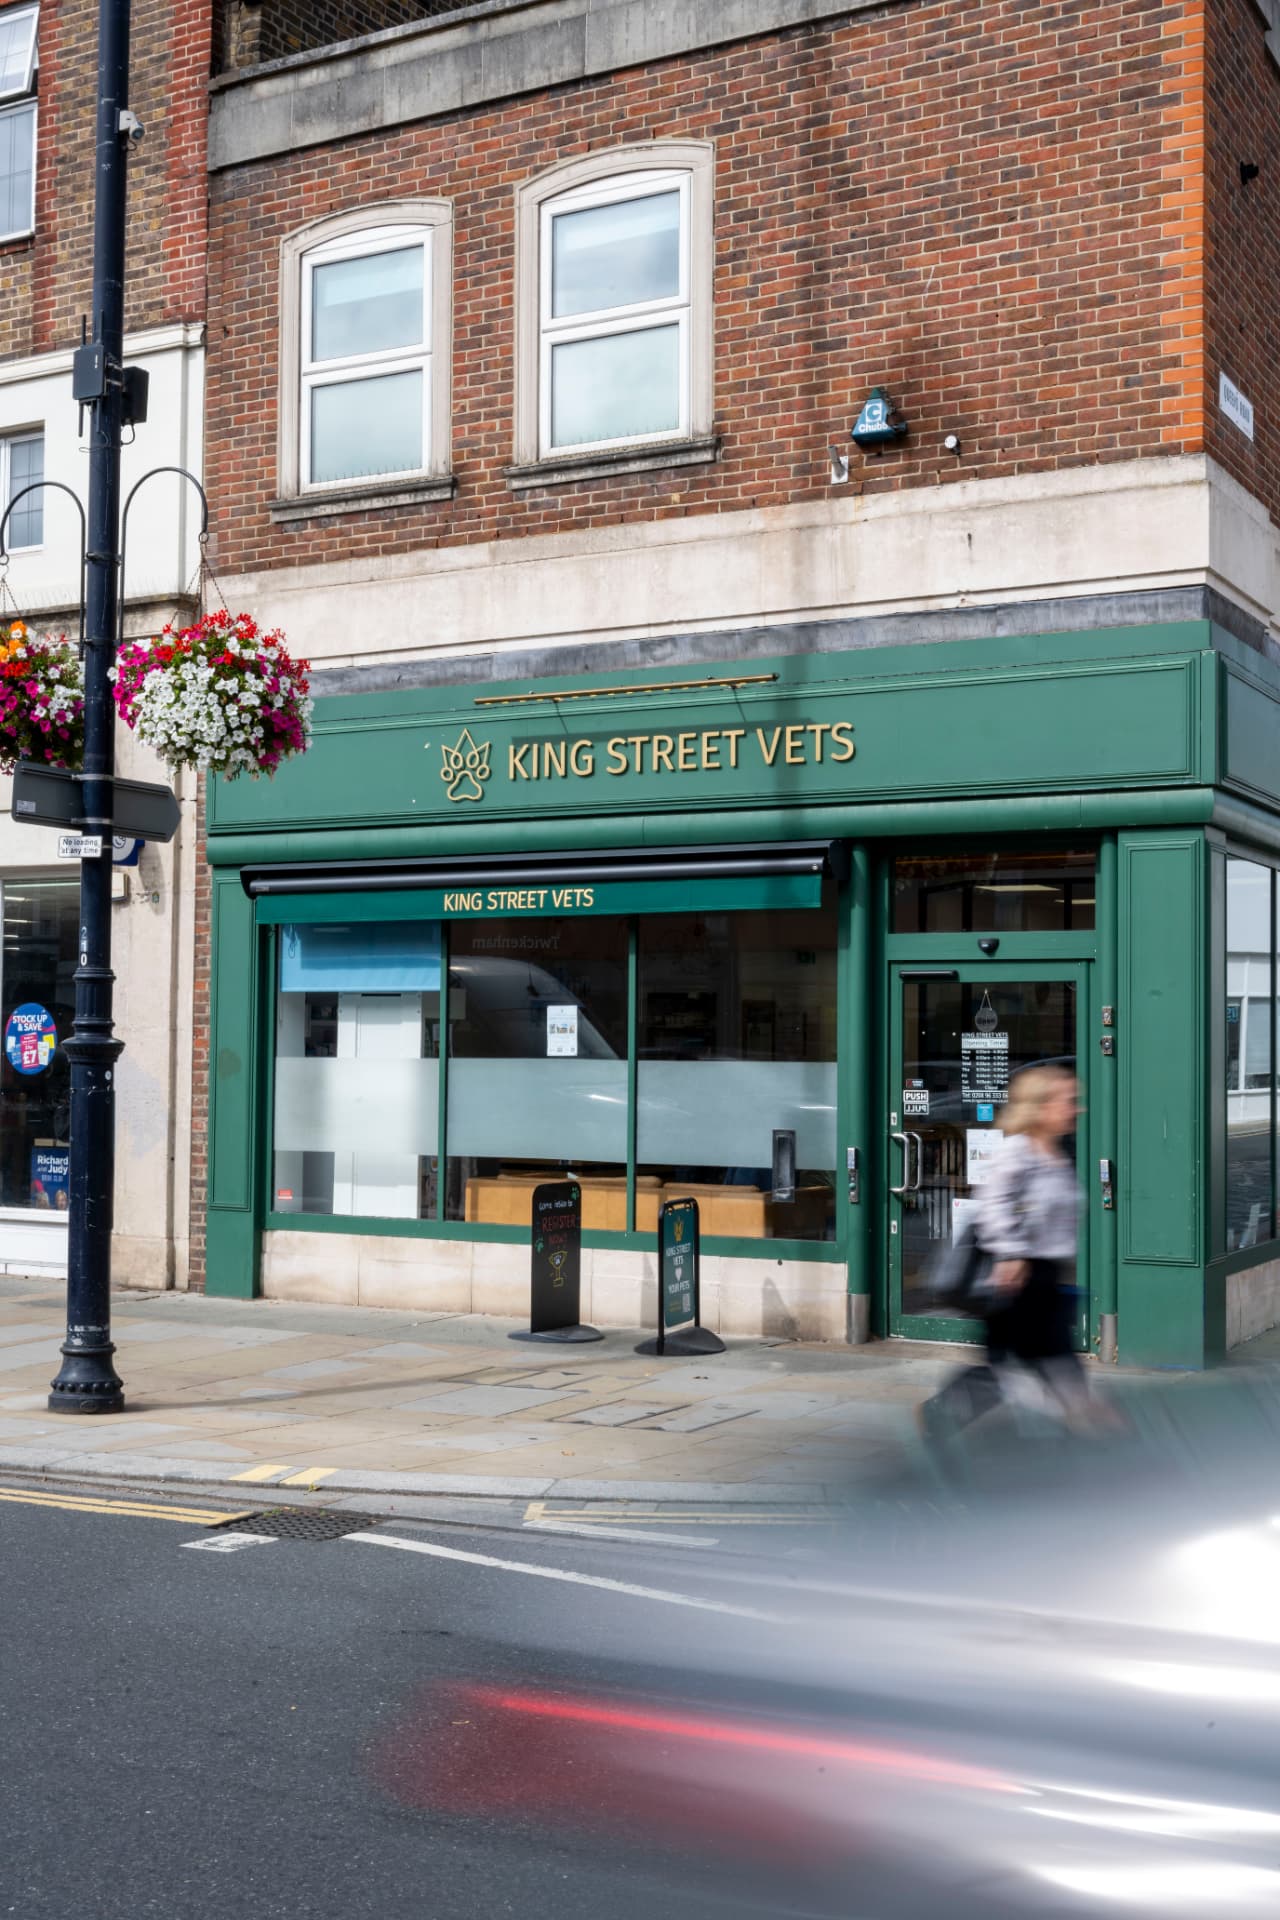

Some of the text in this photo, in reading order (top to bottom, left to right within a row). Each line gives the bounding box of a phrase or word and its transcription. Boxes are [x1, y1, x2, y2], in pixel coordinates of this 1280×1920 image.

[858, 422, 889, 433] Chubb
[508, 721, 856, 781] KING STREET VETS
[73, 838, 98, 848] loading
[443, 887, 595, 912] KING STREET VETS
[12, 1014, 48, 1025] STOCK UP
[24, 1022, 42, 1032] SAVE
[23, 1049, 37, 1065] £7
[905, 1092, 926, 1100] PUSH
[37, 1154, 69, 1166] Richard
[47, 1165, 69, 1176] Judy
[542, 1215, 576, 1232] REGISTER
[677, 1242, 691, 1255] STREET
[673, 1255, 684, 1266] VETS
[668, 1281, 690, 1295] YOUR PETS
